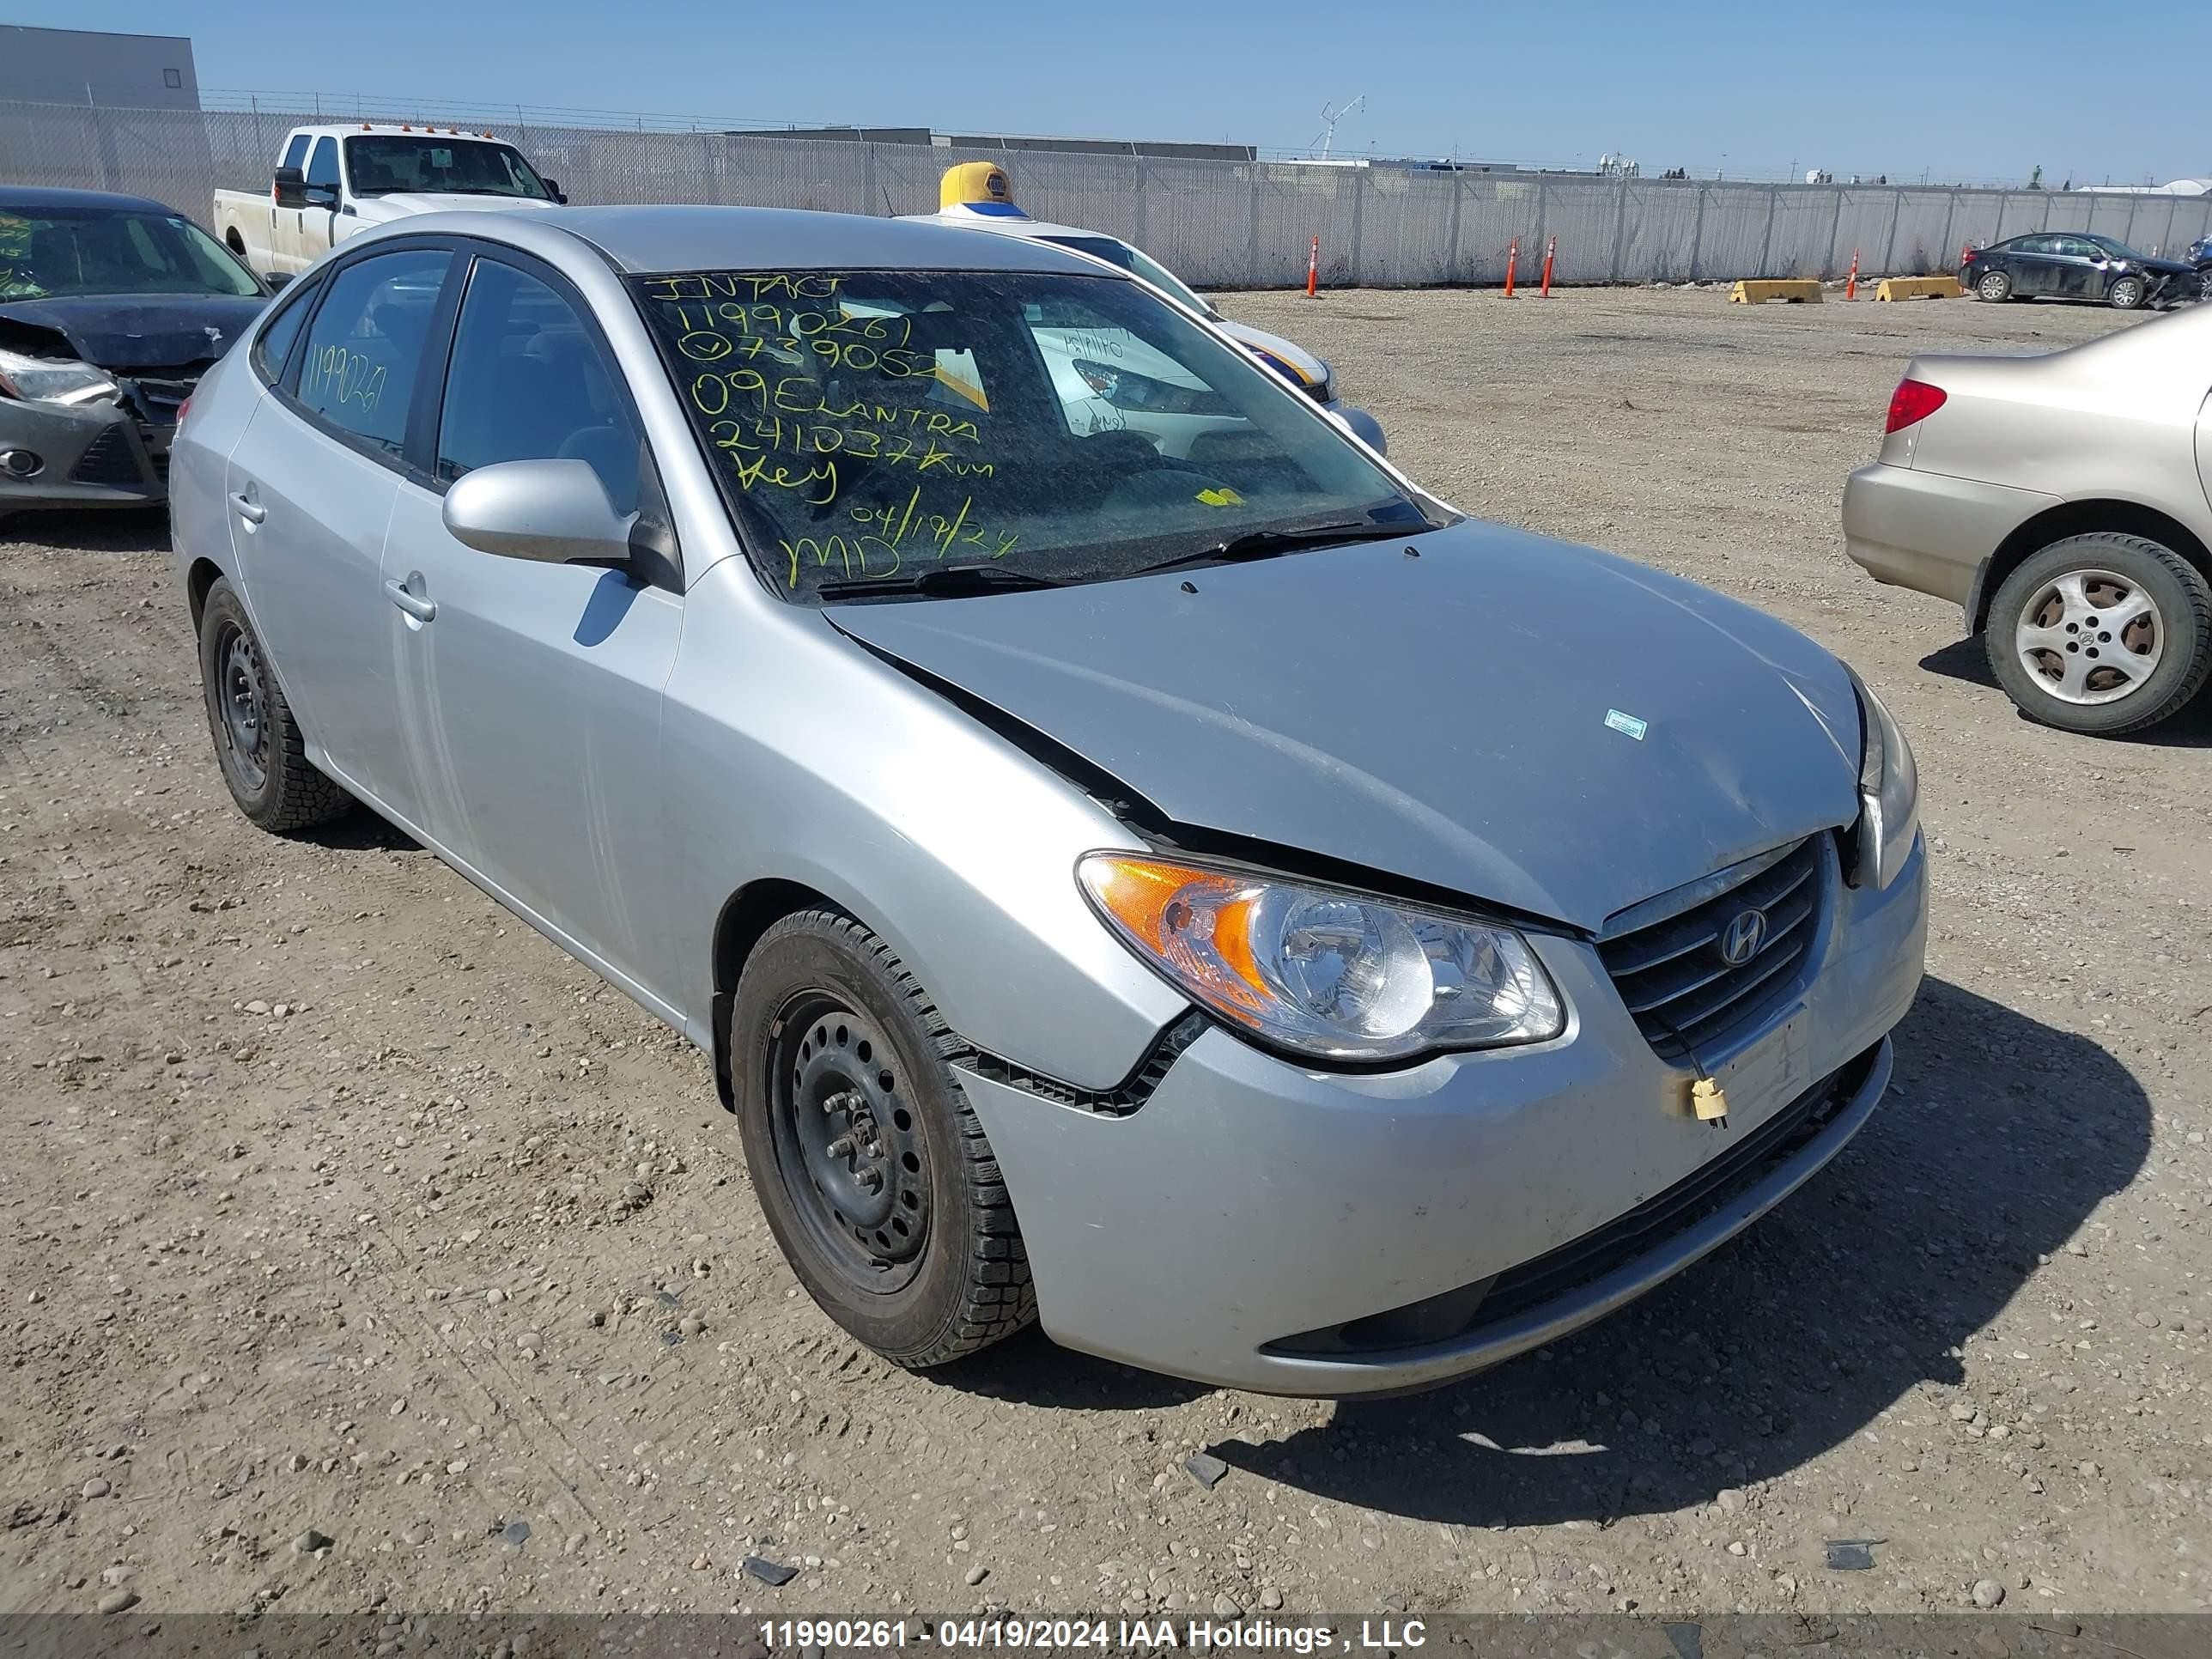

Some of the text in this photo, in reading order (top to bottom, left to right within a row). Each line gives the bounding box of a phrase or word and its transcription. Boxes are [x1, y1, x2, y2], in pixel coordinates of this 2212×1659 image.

[644, 276, 850, 302] INTACT
[677, 302, 912, 348] 11990261
[729, 451, 838, 505] Key
